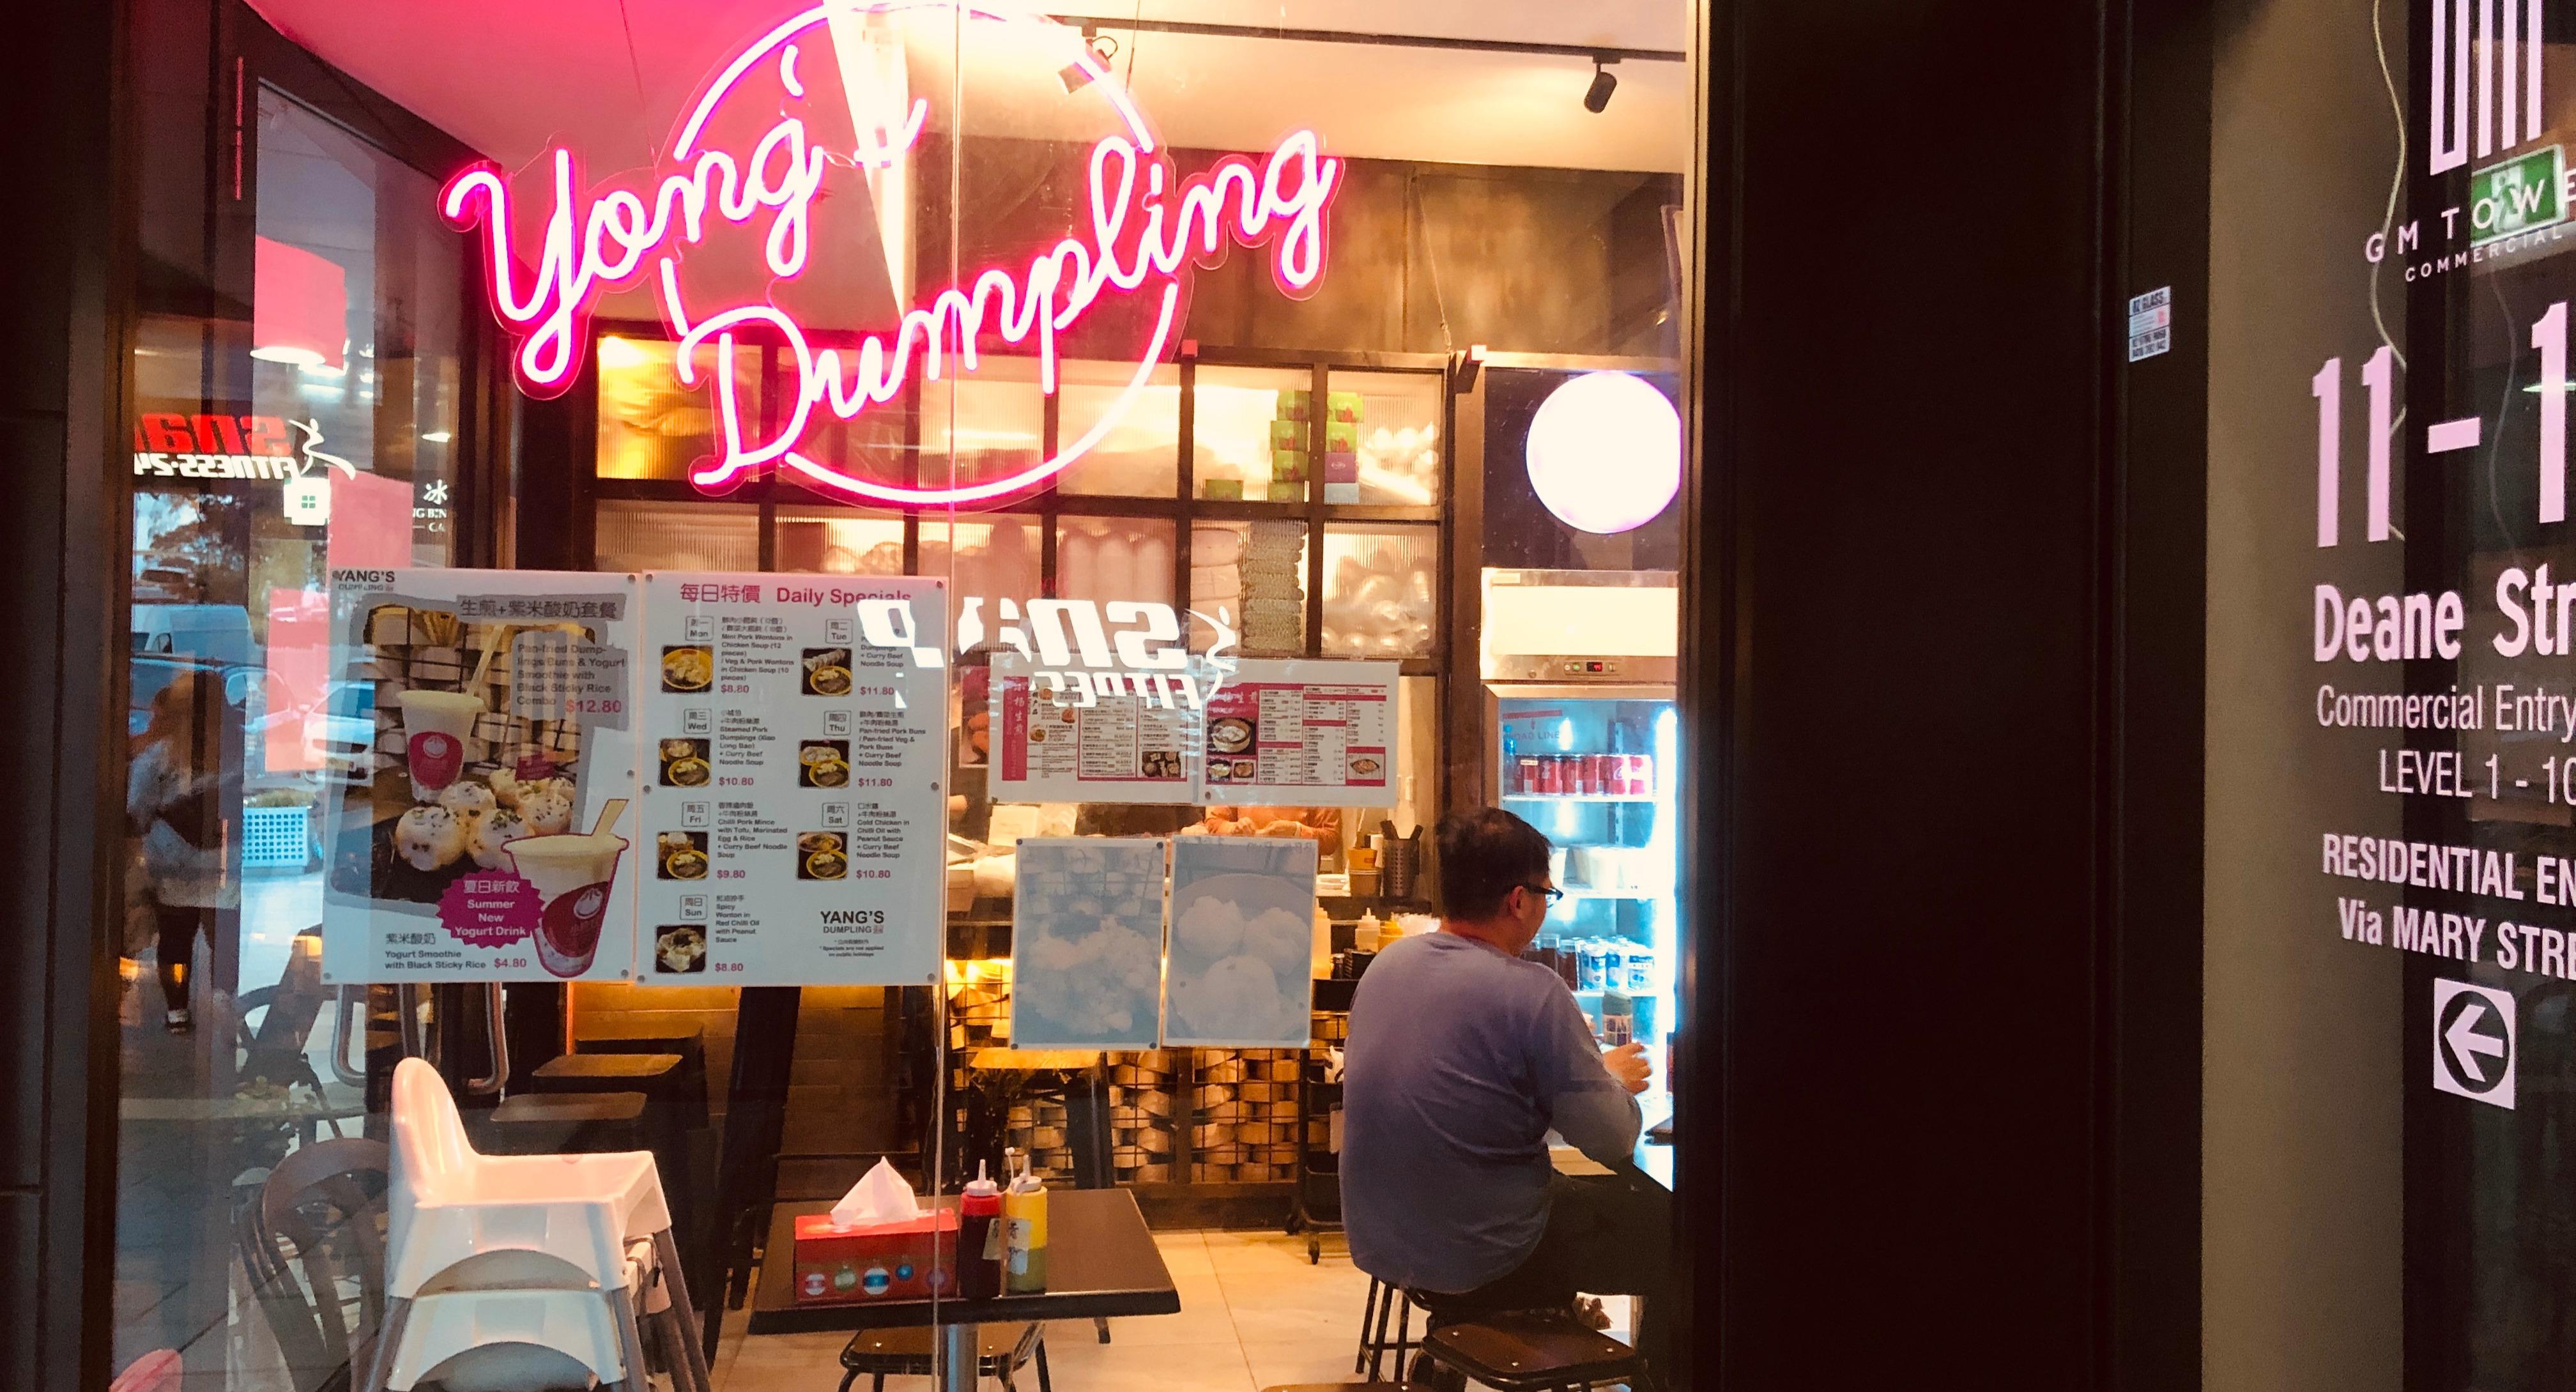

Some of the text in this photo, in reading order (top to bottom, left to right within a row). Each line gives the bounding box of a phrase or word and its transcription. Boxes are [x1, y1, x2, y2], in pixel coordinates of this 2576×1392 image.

[2366, 220, 2418, 263] GM
[2405, 226, 2563, 282] COMMERCIAL
[676, 130, 1337, 486] Dumpling
[2312, 345, 2392, 548] 11
[680, 583, 761, 604] 每日特價
[777, 587, 824, 608] Daily
[2314, 584, 2465, 662] Deane
[578, 658, 585, 667] &
[588, 657, 625, 669] Yogurt
[572, 671, 595, 680] with
[551, 684, 584, 694] Sticky
[587, 684, 611, 693] Rice
[721, 685, 749, 694] $8.80
[860, 687, 894, 696] $11.80
[565, 699, 622, 714] $12.80
[2317, 684, 2576, 744] Commercial Entry
[2379, 749, 2474, 798] LEVEL
[2485, 753, 2499, 800] 1
[719, 777, 754, 786] $10.80
[858, 777, 893, 787] $11.80
[2323, 833, 2524, 901] RESIDENTIAL
[717, 869, 746, 879] $9.80
[856, 869, 891, 879] $10.80
[467, 899, 516, 909] Summer
[479, 913, 504, 922] New
[455, 926, 526, 938] Yogurt Drink
[2338, 897, 2382, 946] Via
[2393, 906, 2487, 963] MARY
[385, 950, 462, 960] Yogurt Smoothie
[435, 961, 463, 970] Sticky
[494, 958, 527, 968] $4.80
[715, 963, 744, 972] $8.80
